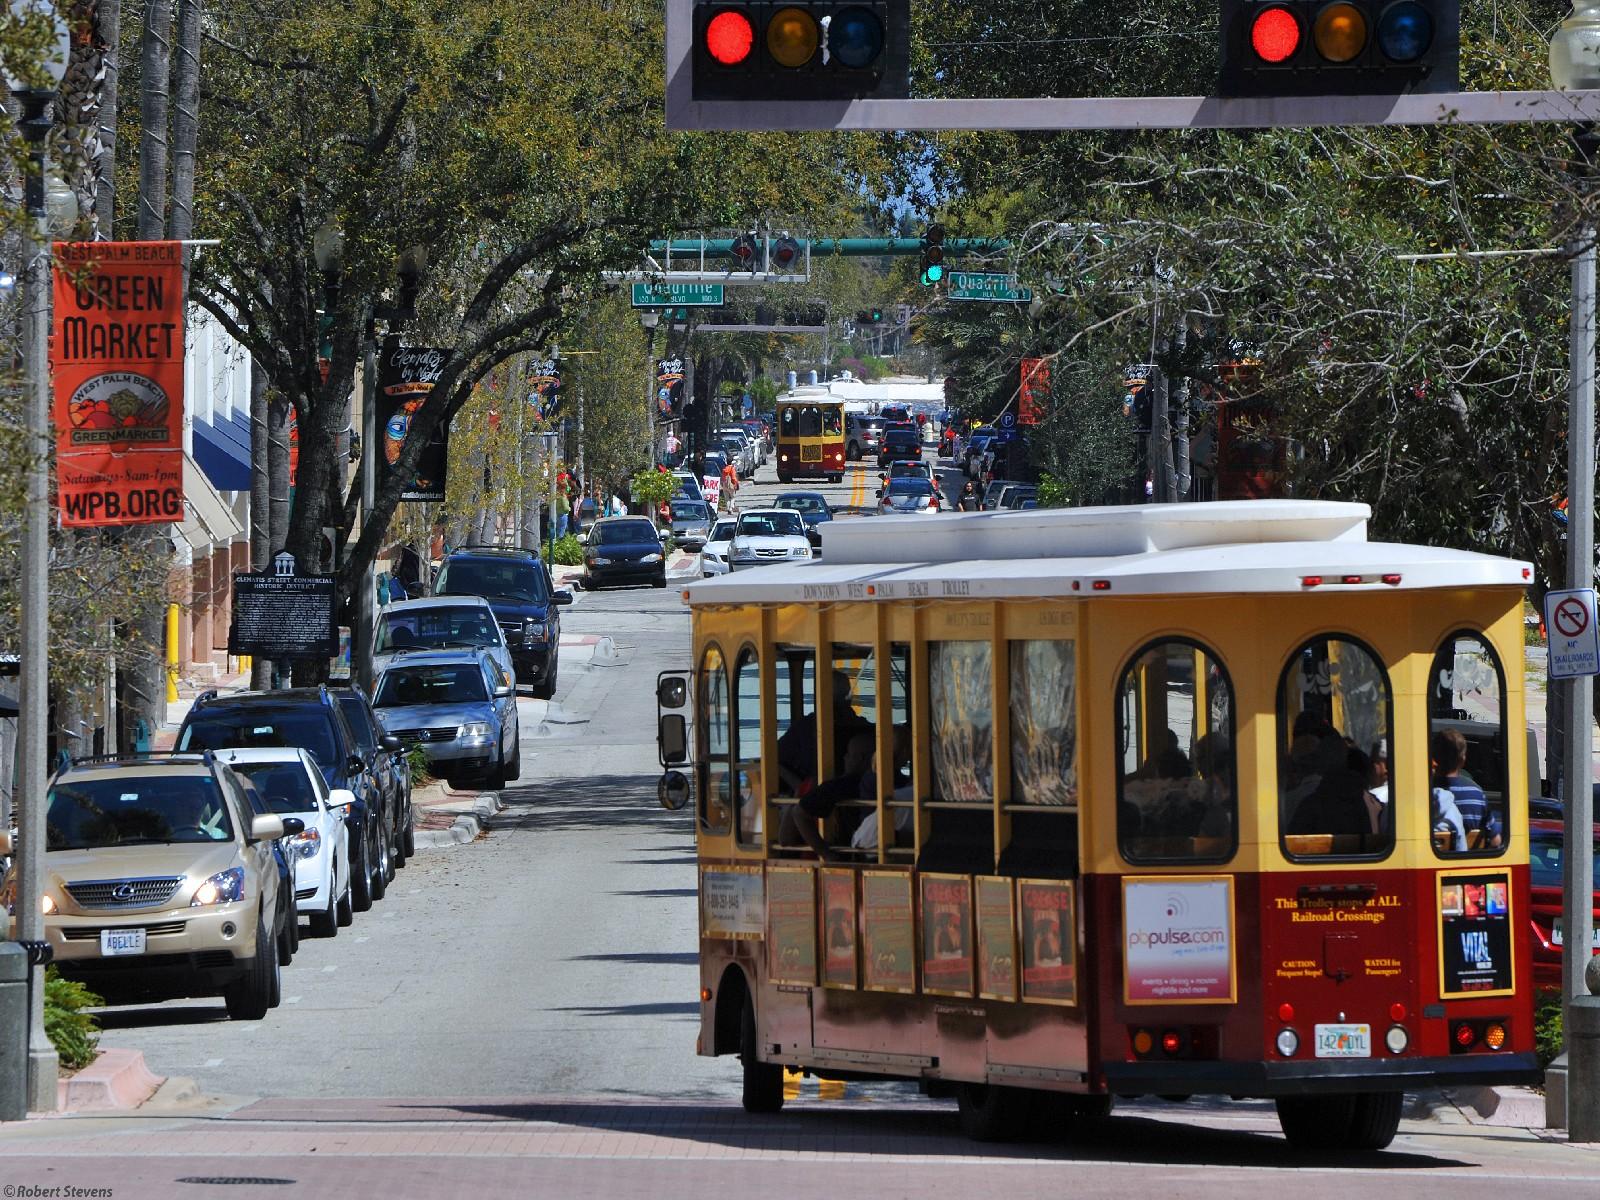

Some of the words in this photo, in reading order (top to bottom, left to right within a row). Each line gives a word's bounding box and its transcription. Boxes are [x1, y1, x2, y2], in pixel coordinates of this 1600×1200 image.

[97, 246, 130, 261] PALM
[135, 246, 175, 261] BEACH
[76, 275, 163, 311] GREEN
[64, 317, 176, 359] MARKET
[74, 380, 100, 401] WEST
[103, 374, 131, 384] PALM
[133, 376, 165, 400] BEACH
[72, 429, 168, 442] GREENMARKET
[65, 488, 179, 520] WPB.ORG
[847, 583, 864, 598] WEST
[942, 580, 970, 595] TROLLEY
[1275, 898, 1297, 908] This
[1302, 898, 1334, 911] Trolley
[1366, 898, 1375, 906] at
[1378, 896, 1401, 906] ALL
[1292, 912, 1334, 922] Railroad
[1336, 910, 1385, 924] Crossings
[1129, 928, 1224, 949] pbpulse.com
[1282, 960, 1316, 968] CAUTION
[1364, 959, 1391, 967] WATCH
[1276, 970, 1303, 978] Frequent
